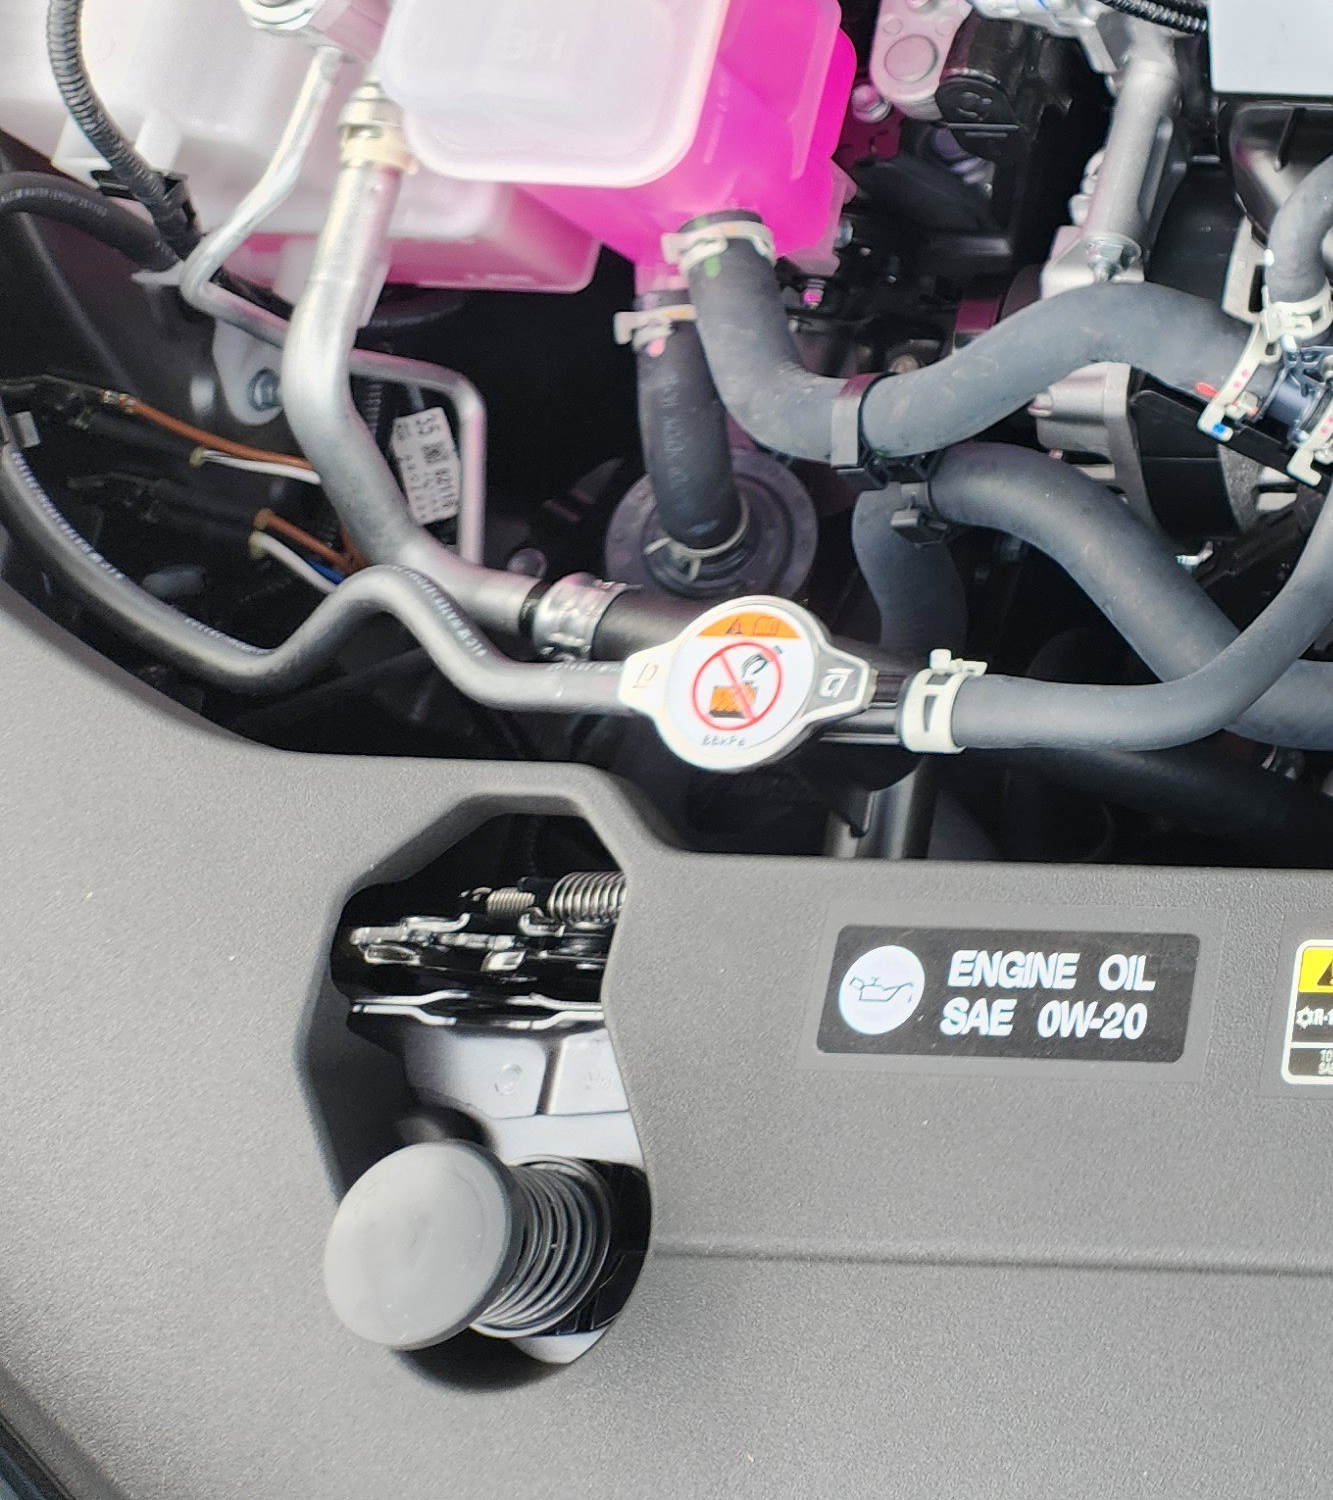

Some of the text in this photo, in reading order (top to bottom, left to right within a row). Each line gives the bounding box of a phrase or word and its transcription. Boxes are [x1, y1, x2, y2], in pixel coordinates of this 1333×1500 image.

[947, 949, 1156, 991] ENGINE OIL
[939, 996, 1149, 1041] SAE 0W-20
